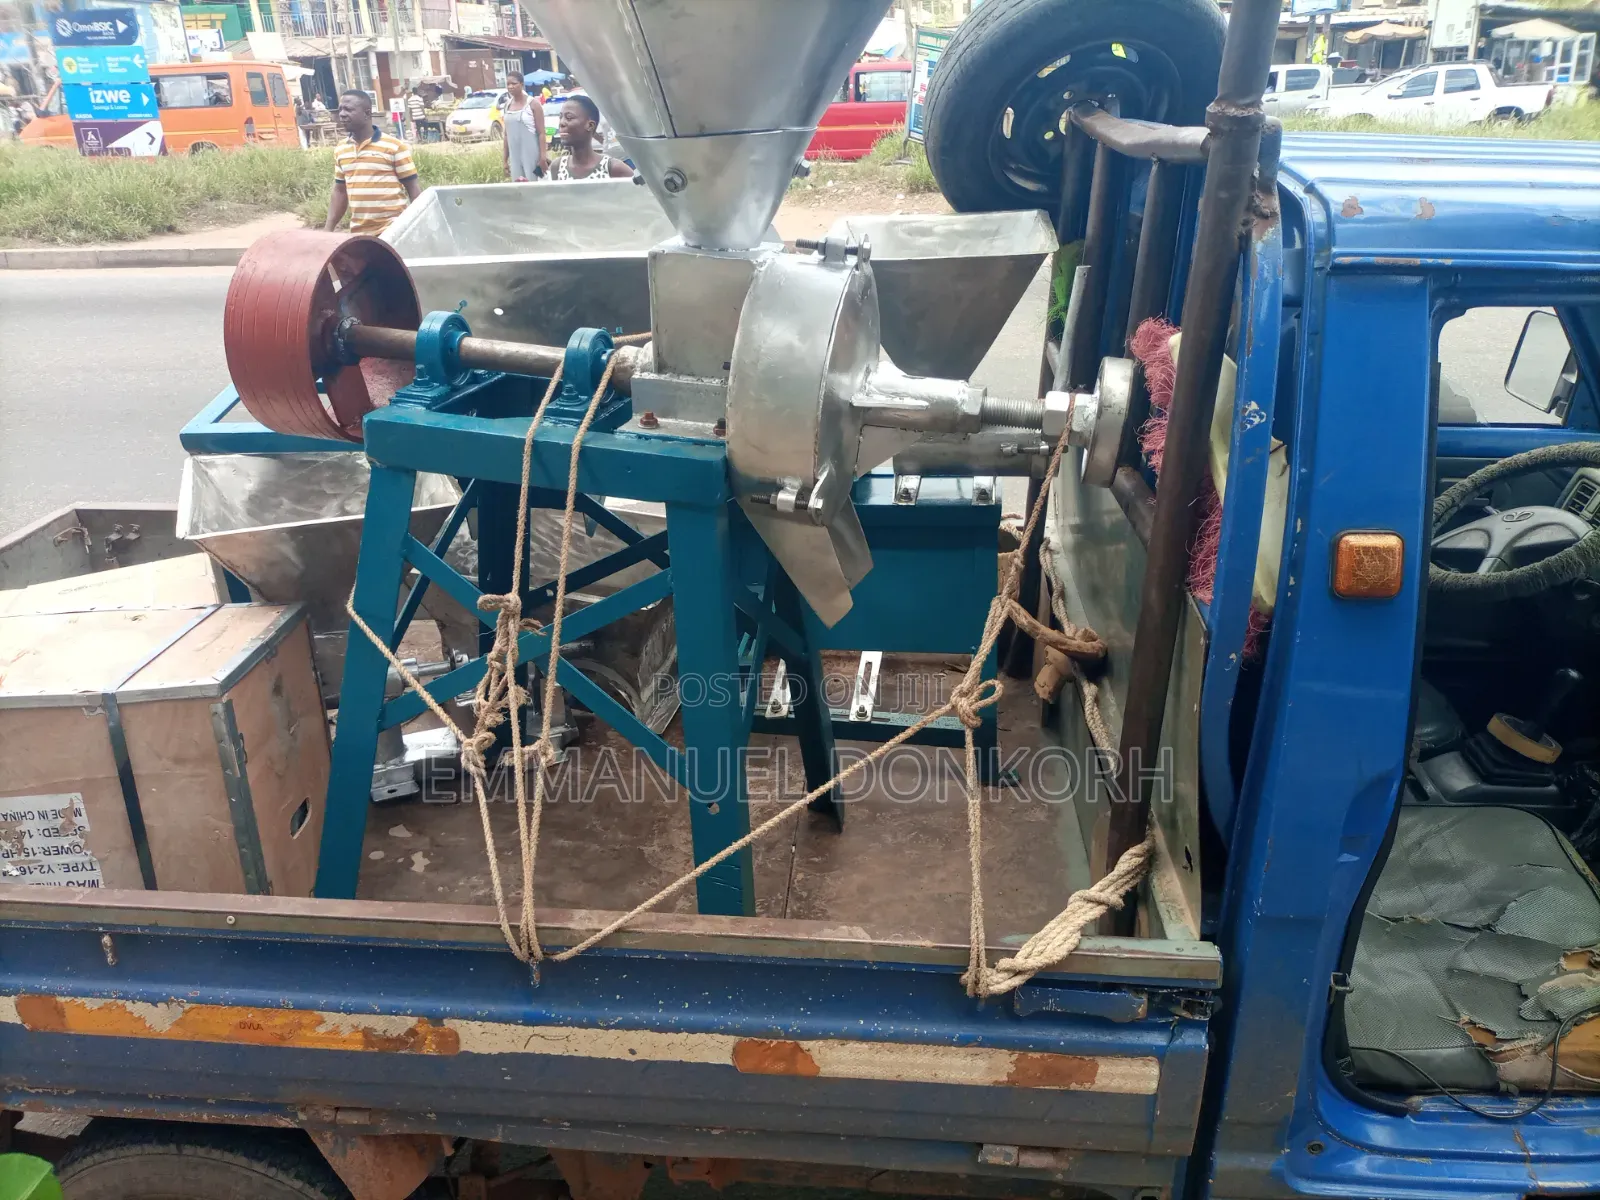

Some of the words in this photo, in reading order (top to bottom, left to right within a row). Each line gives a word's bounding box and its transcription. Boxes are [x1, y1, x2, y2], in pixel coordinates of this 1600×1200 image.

[88, 87, 131, 104] izwe
[1, 810, 34, 821] CHINA
[37, 810, 49, 820] IN
[50, 807, 82, 820] MDE
[23, 844, 89, 857] OWER:15
[59, 861, 97, 873] TYPE:
